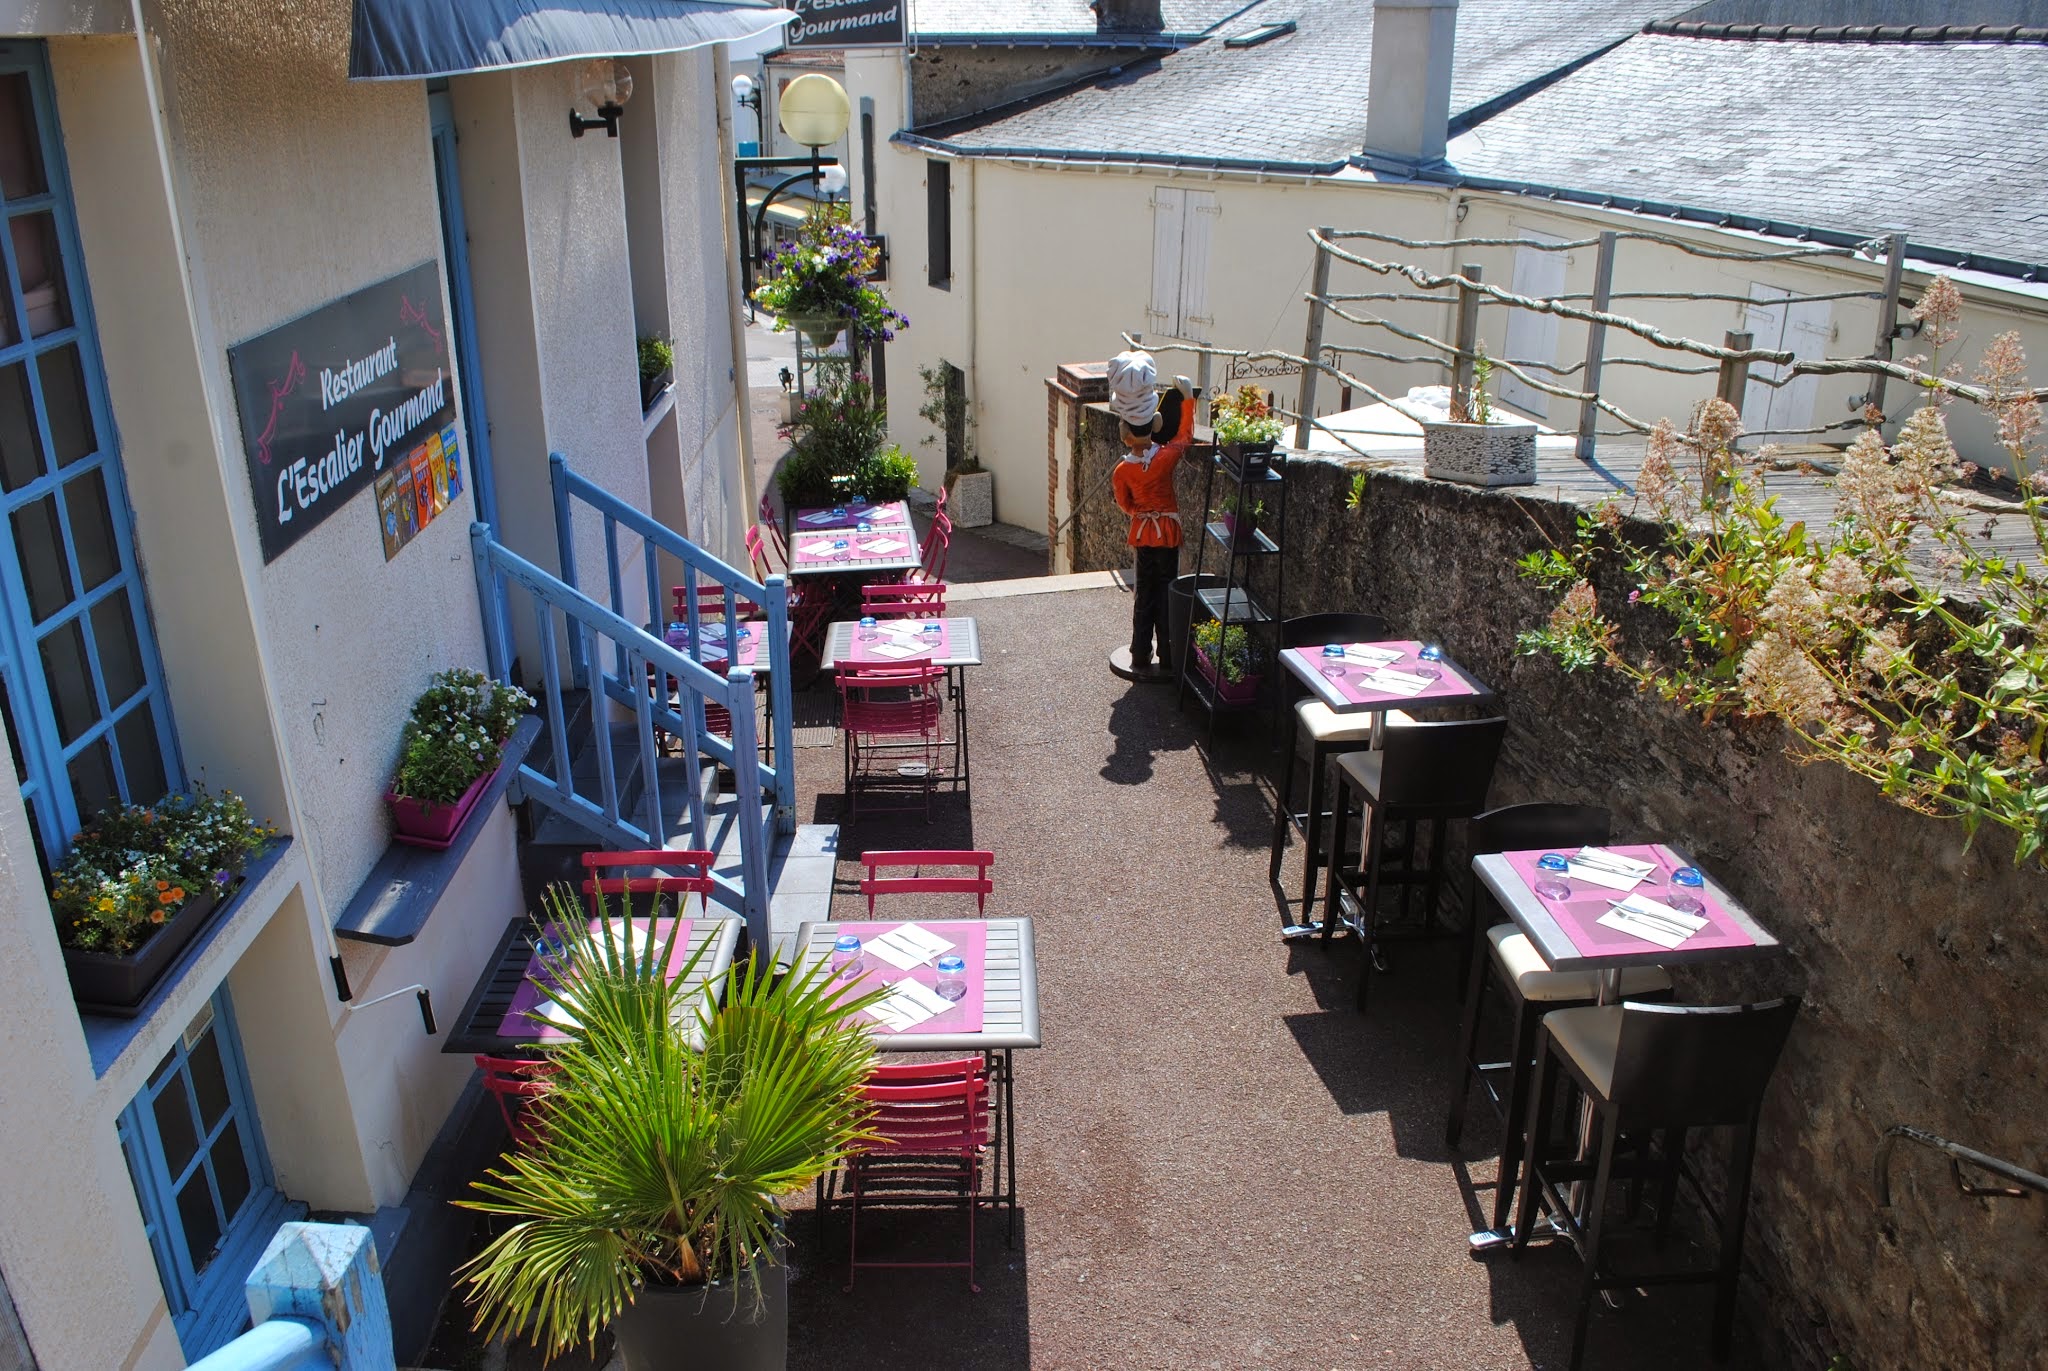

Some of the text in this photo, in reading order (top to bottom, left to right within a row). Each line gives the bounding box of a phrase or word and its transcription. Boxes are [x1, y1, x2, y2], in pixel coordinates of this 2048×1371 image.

[790, 5, 897, 43] Gourmand
[320, 336, 398, 411] Restaurant
[278, 367, 445, 525] L'Escalier Gourmand
[382, 491, 397, 511] 2013
